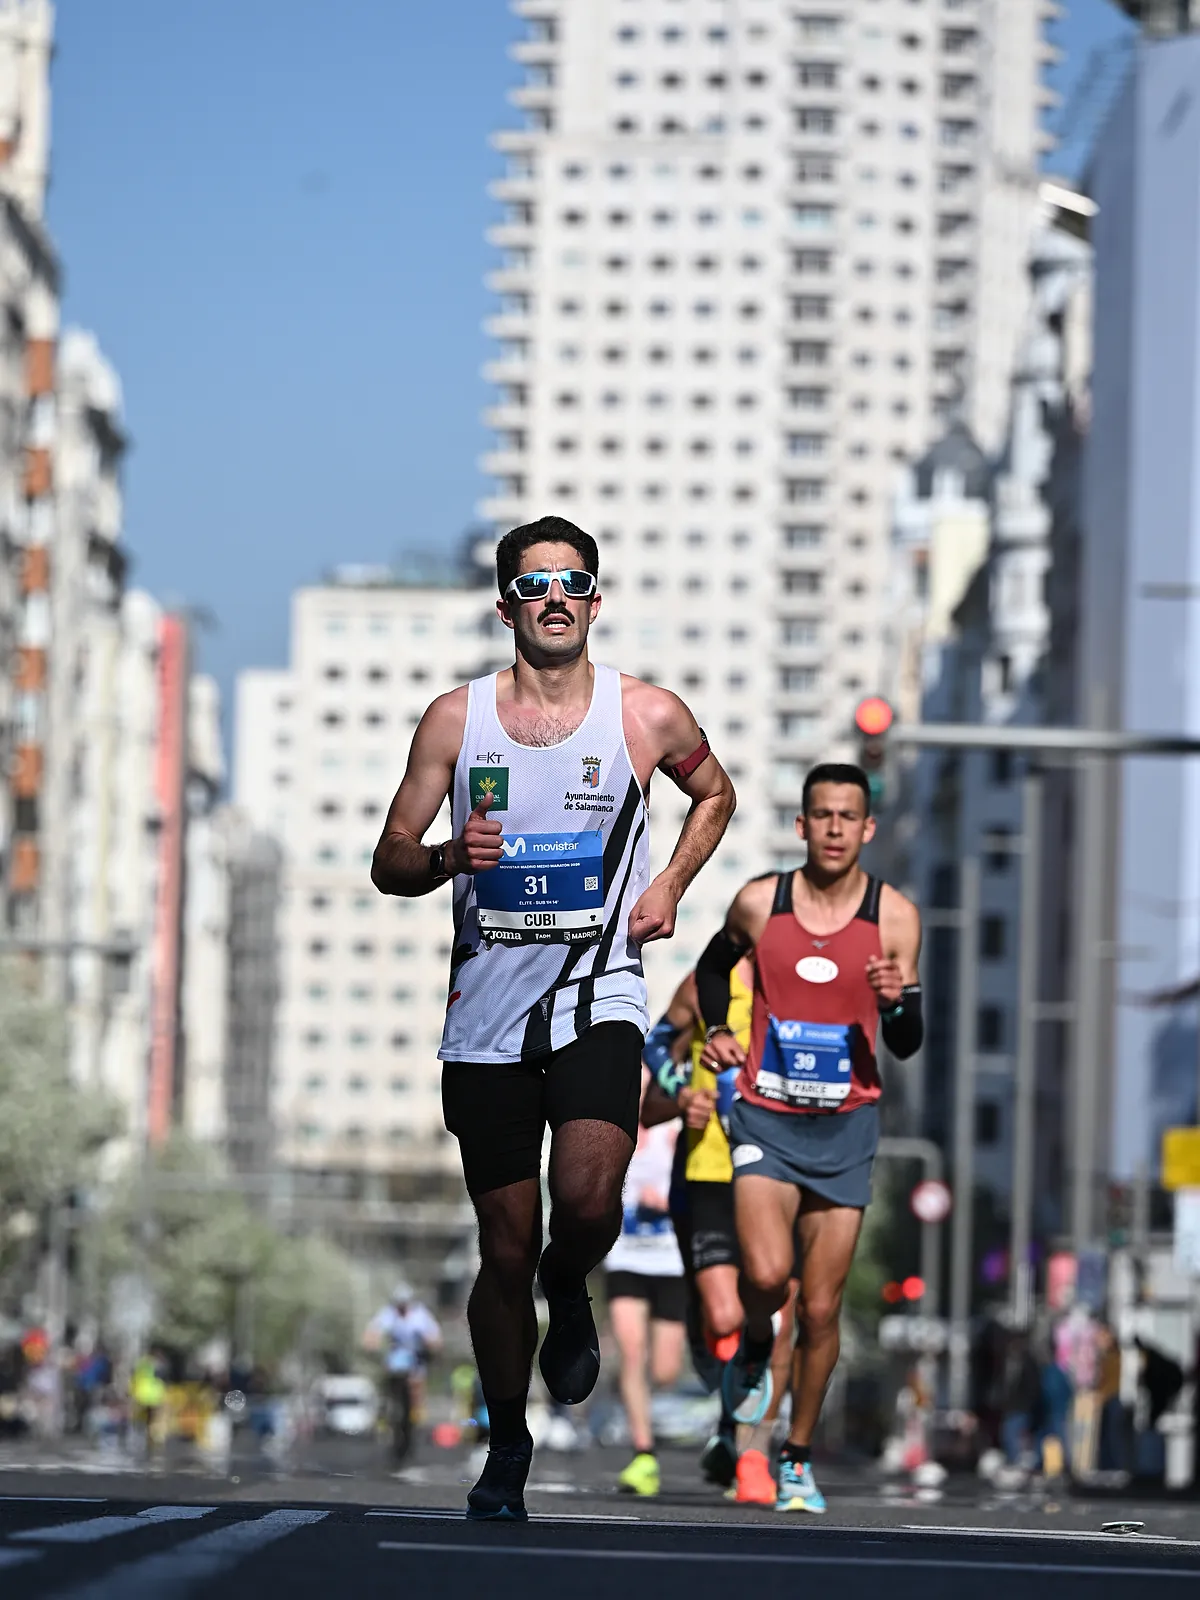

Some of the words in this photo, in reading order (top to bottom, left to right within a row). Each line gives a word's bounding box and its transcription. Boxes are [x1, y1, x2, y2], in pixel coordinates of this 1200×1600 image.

[476, 751, 504, 764] EKT
[564, 791, 615, 803] Ayuntamiento
[564, 802, 574, 810] de
[575, 802, 614, 812] Salamanca
[532, 841, 580, 852] movistar
[524, 875, 548, 895] 31
[524, 913, 556, 927] CUBI
[571, 930, 597, 940] MADRID
